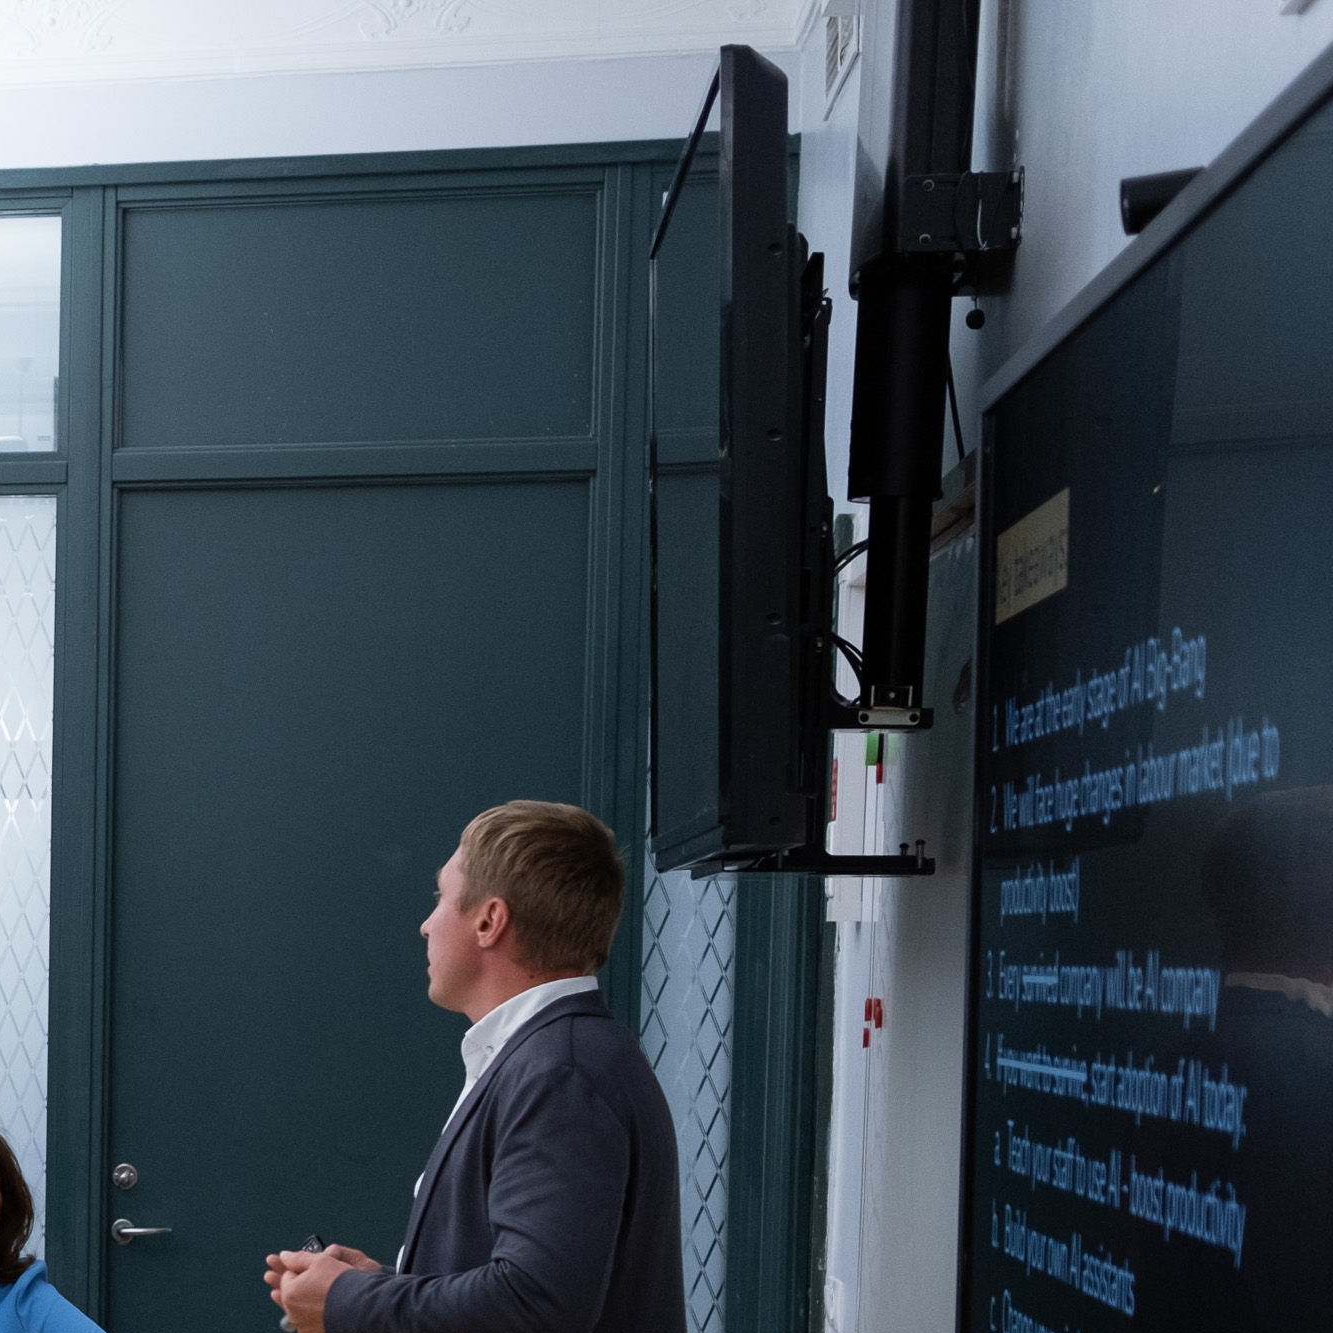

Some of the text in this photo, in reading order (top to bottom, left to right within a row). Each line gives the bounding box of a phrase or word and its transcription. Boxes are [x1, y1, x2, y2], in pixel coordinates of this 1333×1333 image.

[1004, 699, 1019, 746] We
[1019, 703, 1034, 744] are
[1045, 681, 1061, 735] the
[1062, 668, 1086, 734] early
[1086, 668, 1116, 730] stage
[1117, 648, 1132, 709] of
[1131, 644, 1145, 704] AI
[1146, 627, 1206, 711] Big-Bang
[1003, 784, 1017, 830] We
[1034, 774, 1054, 824] face
[1054, 768, 1078, 831] huge
[1079, 758, 1123, 825] changes
[1124, 749, 1136, 806] in
[1136, 742, 1176, 805] labour
[1177, 726, 1224, 795] market
[1260, 714, 1280, 779] to
[998, 949, 1021, 1012] Every
[1059, 966, 1103, 1018] company
[1127, 950, 1142, 1011] be
[1143, 952, 1159, 1011] AI
[1159, 967, 1221, 1030] company
[1041, 1045, 1052, 1093] to
[1090, 1052, 1115, 1107] start
[1116, 1050, 1167, 1126] adoption
[1169, 1056, 1184, 1121] of
[1184, 1060, 1201, 1124] AI
[1006, 1119, 1030, 1175] Teach
[1031, 1141, 1052, 1191] your
[1052, 1137, 1075, 1191] staff
[1075, 1145, 1085, 1197] to
[1087, 1160, 1106, 1203] use
[1107, 1150, 1121, 1208] AI
[1129, 1156, 1165, 1225] boost
[1003, 1204, 1026, 1261] Build
[1026, 1228, 1047, 1276] your
[1046, 1237, 1068, 1282] own
[1069, 1234, 1081, 1288] AI
[1081, 1247, 1135, 1316] assistants
